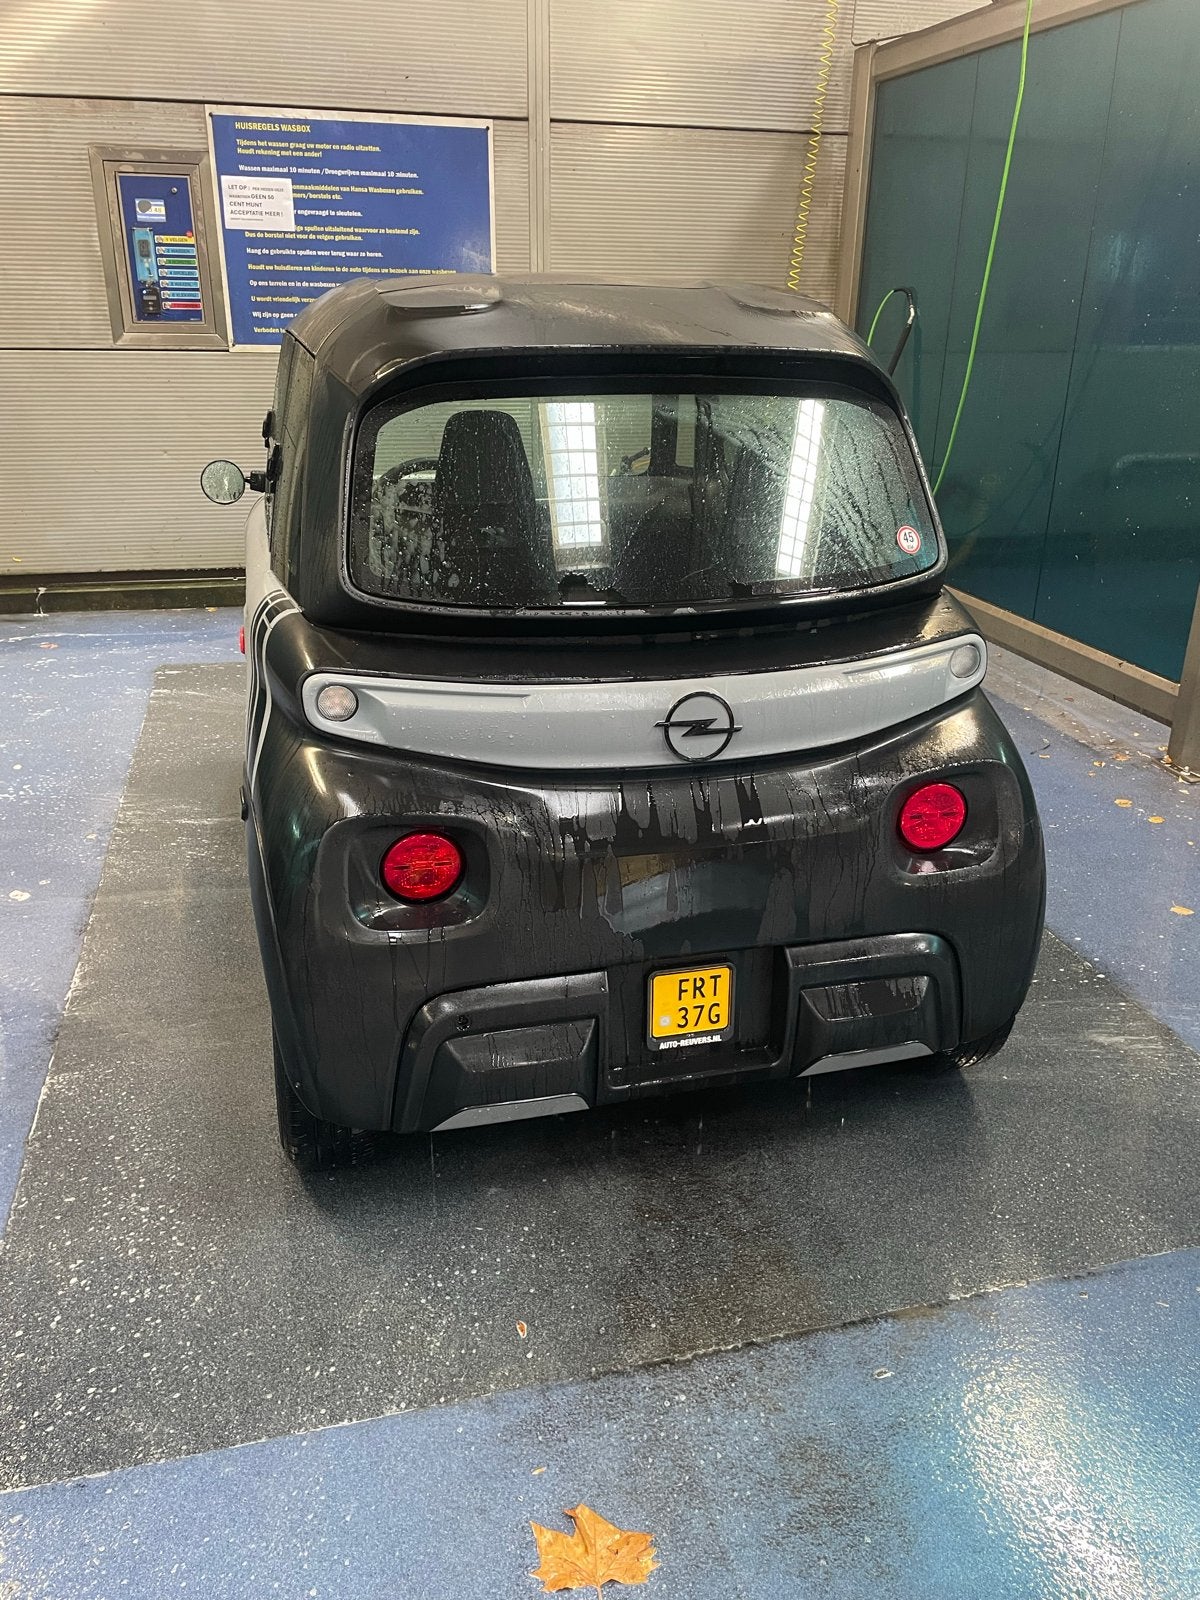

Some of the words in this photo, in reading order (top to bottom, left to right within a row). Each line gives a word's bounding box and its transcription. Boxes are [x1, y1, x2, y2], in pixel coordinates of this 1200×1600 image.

[235, 122, 280, 131] HUISREGELS
[281, 124, 311, 132] WASBOX
[236, 139, 256, 148] Tijdens
[290, 142, 306, 150] graag
[256, 148, 280, 156] rekening
[246, 247, 261, 255] Hang
[904, 532, 914, 542] 45
[679, 975, 721, 1001] FRT
[678, 1003, 720, 1028] 37G
[659, 1035, 722, 1049] AUTO-REUVERS.NL
